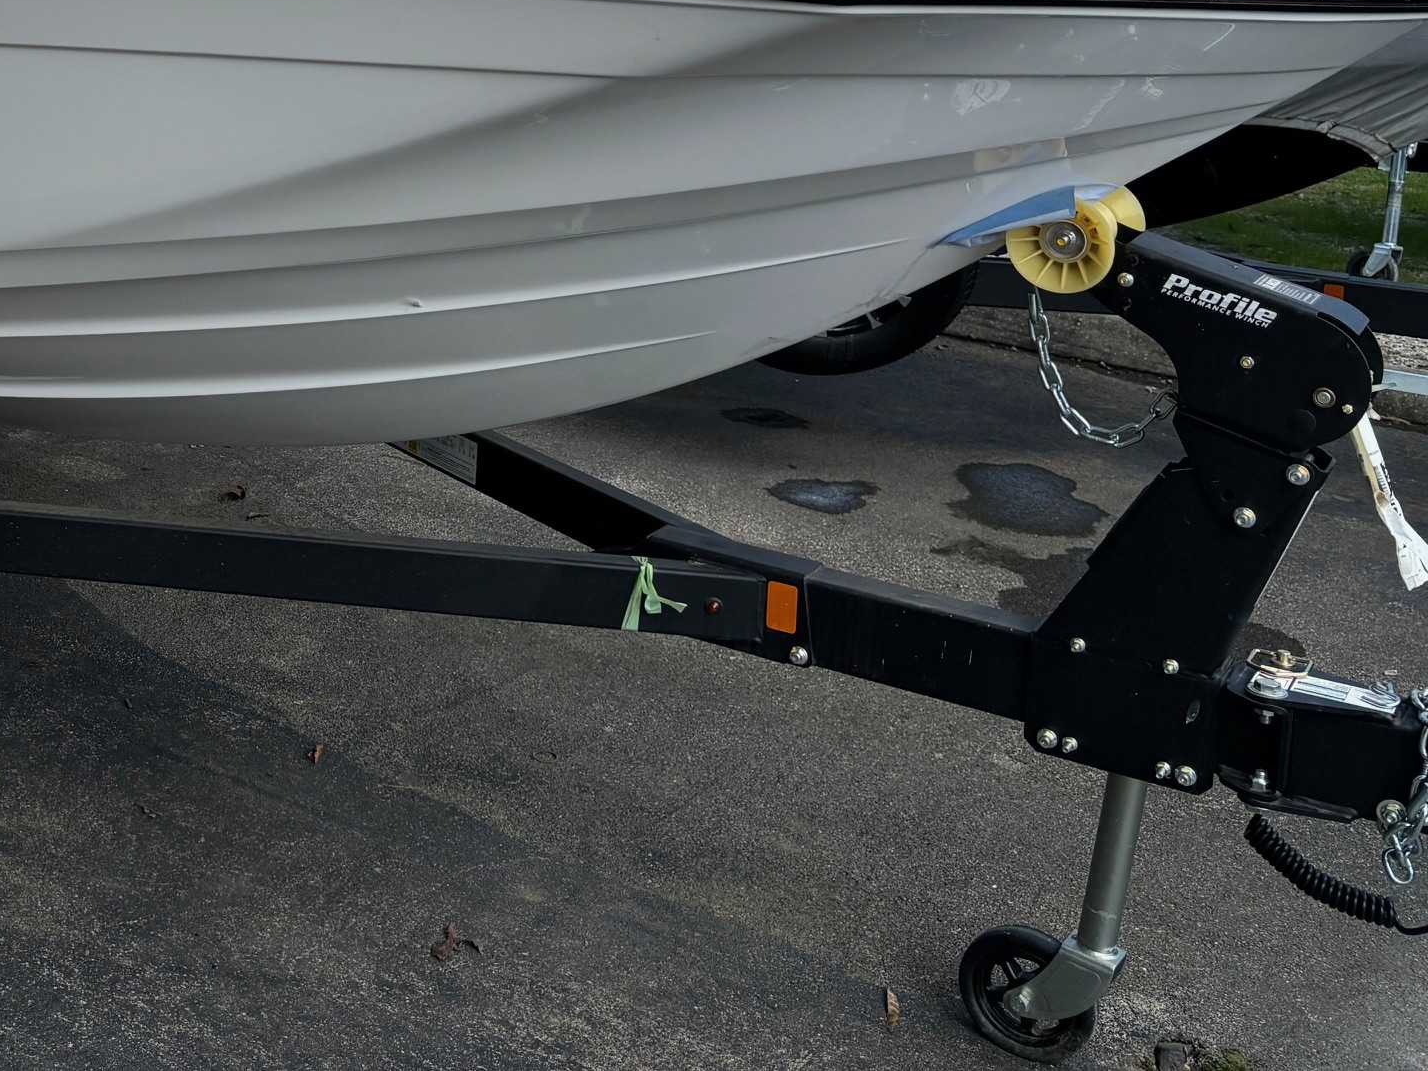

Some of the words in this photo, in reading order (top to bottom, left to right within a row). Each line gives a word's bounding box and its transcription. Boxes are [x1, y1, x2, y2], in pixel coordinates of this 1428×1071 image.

[1160, 288, 1233, 317] PERFORMANCE
[1235, 311, 1271, 329] WINCH
[1163, 273, 1278, 324] Profile
